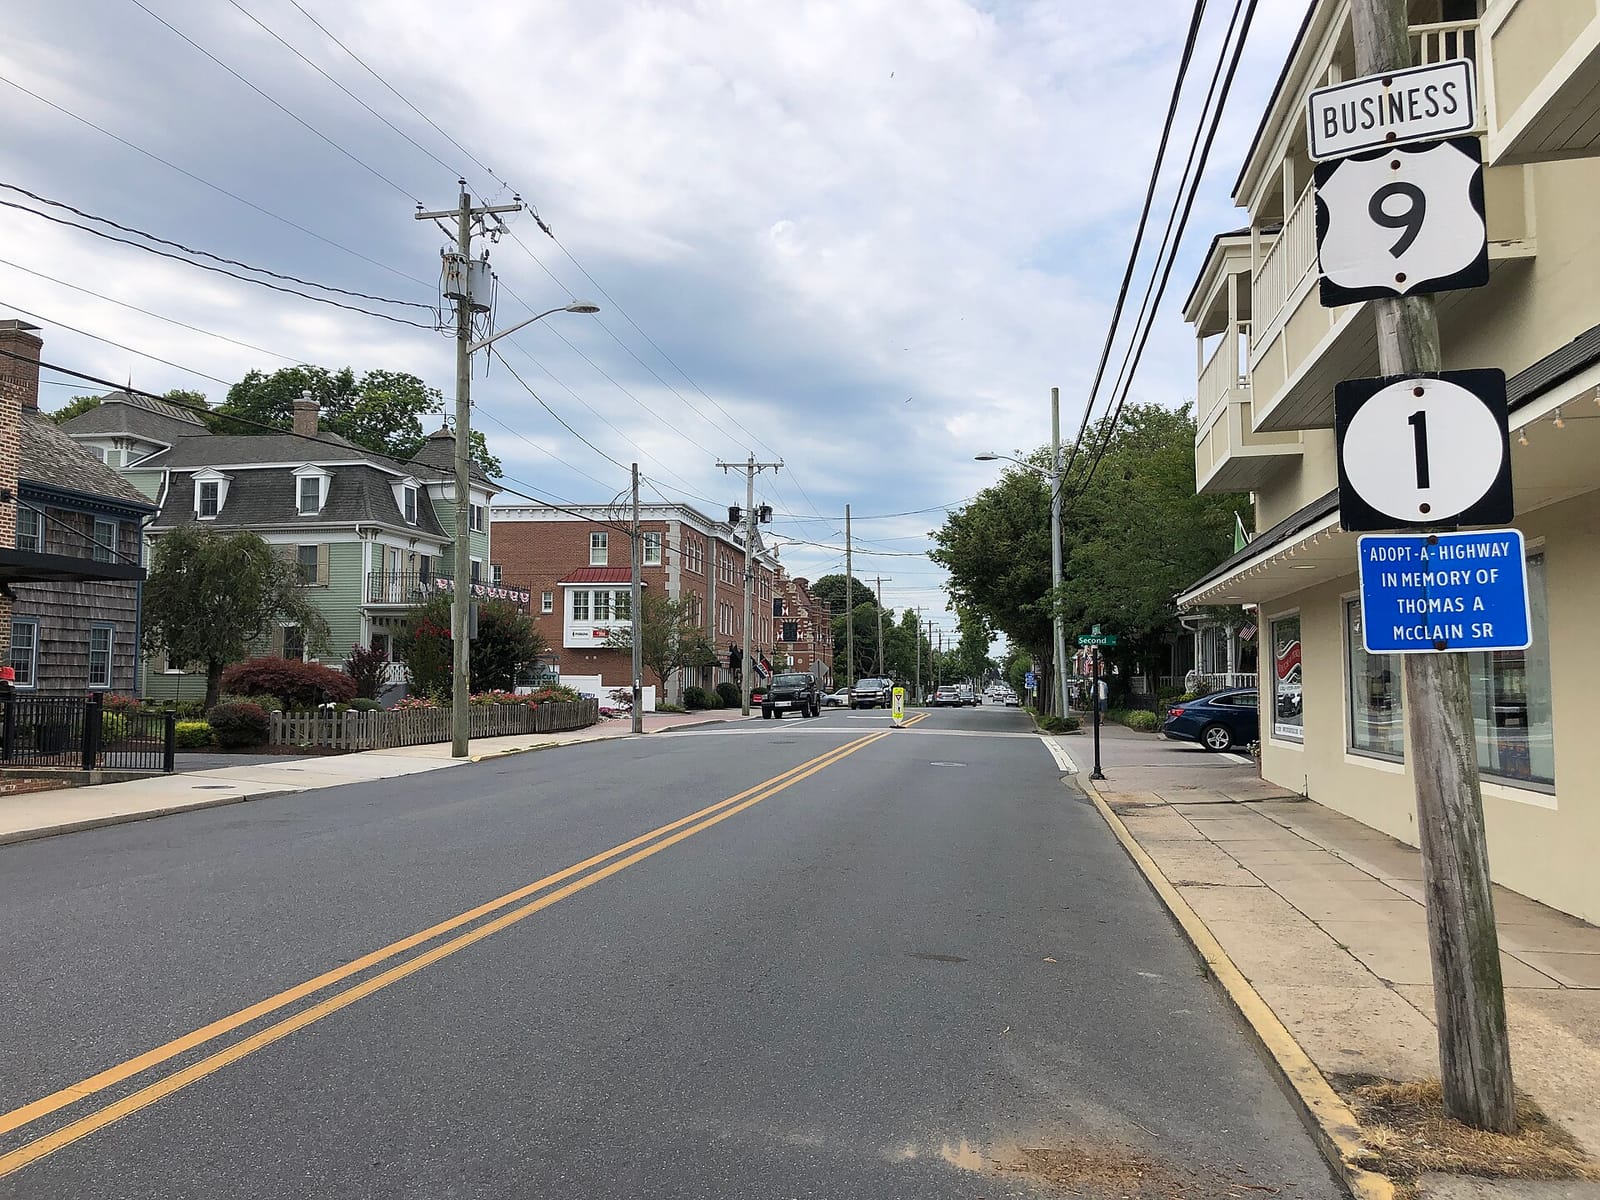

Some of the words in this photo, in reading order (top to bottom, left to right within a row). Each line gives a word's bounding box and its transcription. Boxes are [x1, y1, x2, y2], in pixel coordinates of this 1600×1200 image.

[1323, 81, 1458, 139] BUSINESS
[1368, 181, 1427, 259] 9
[1407, 410, 1430, 491] 1
[1381, 572, 1398, 587] IN
[1401, 569, 1471, 587] MEMORY
[1476, 568, 1499, 584] OF
[1396, 597, 1465, 614] THOMAS
[1472, 596, 1485, 611] A
[1078, 636, 1107, 644] Second
[1393, 624, 1463, 641] McCLAIN
[1471, 622, 1493, 639] SR
